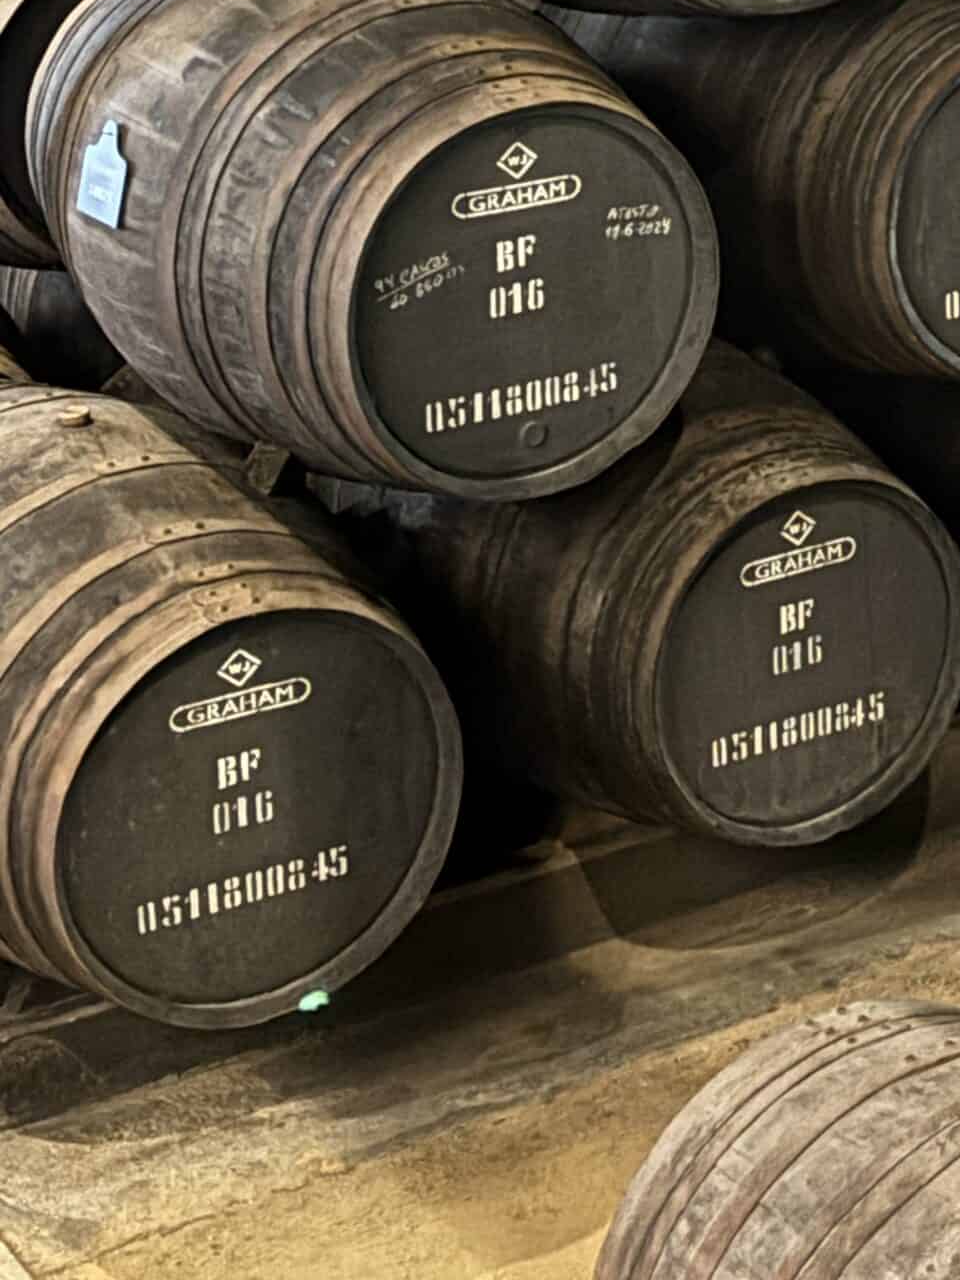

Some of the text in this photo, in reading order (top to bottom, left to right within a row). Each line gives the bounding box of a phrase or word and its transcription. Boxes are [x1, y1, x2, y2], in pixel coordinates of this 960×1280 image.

[469, 180, 567, 213] GRAHAM
[496, 234, 537, 273] BF
[489, 278, 545, 319] 016
[425, 361, 617, 433] 0511800845
[754, 542, 843, 579] GRAHAM
[780, 598, 815, 635] BF
[772, 634, 823, 675] 016
[186, 684, 295, 724] GRAHAM
[712, 691, 885, 768] 0511800845
[217, 748, 262, 790] BF
[213, 790, 273, 835] 016
[137, 845, 348, 935] 0511800845
